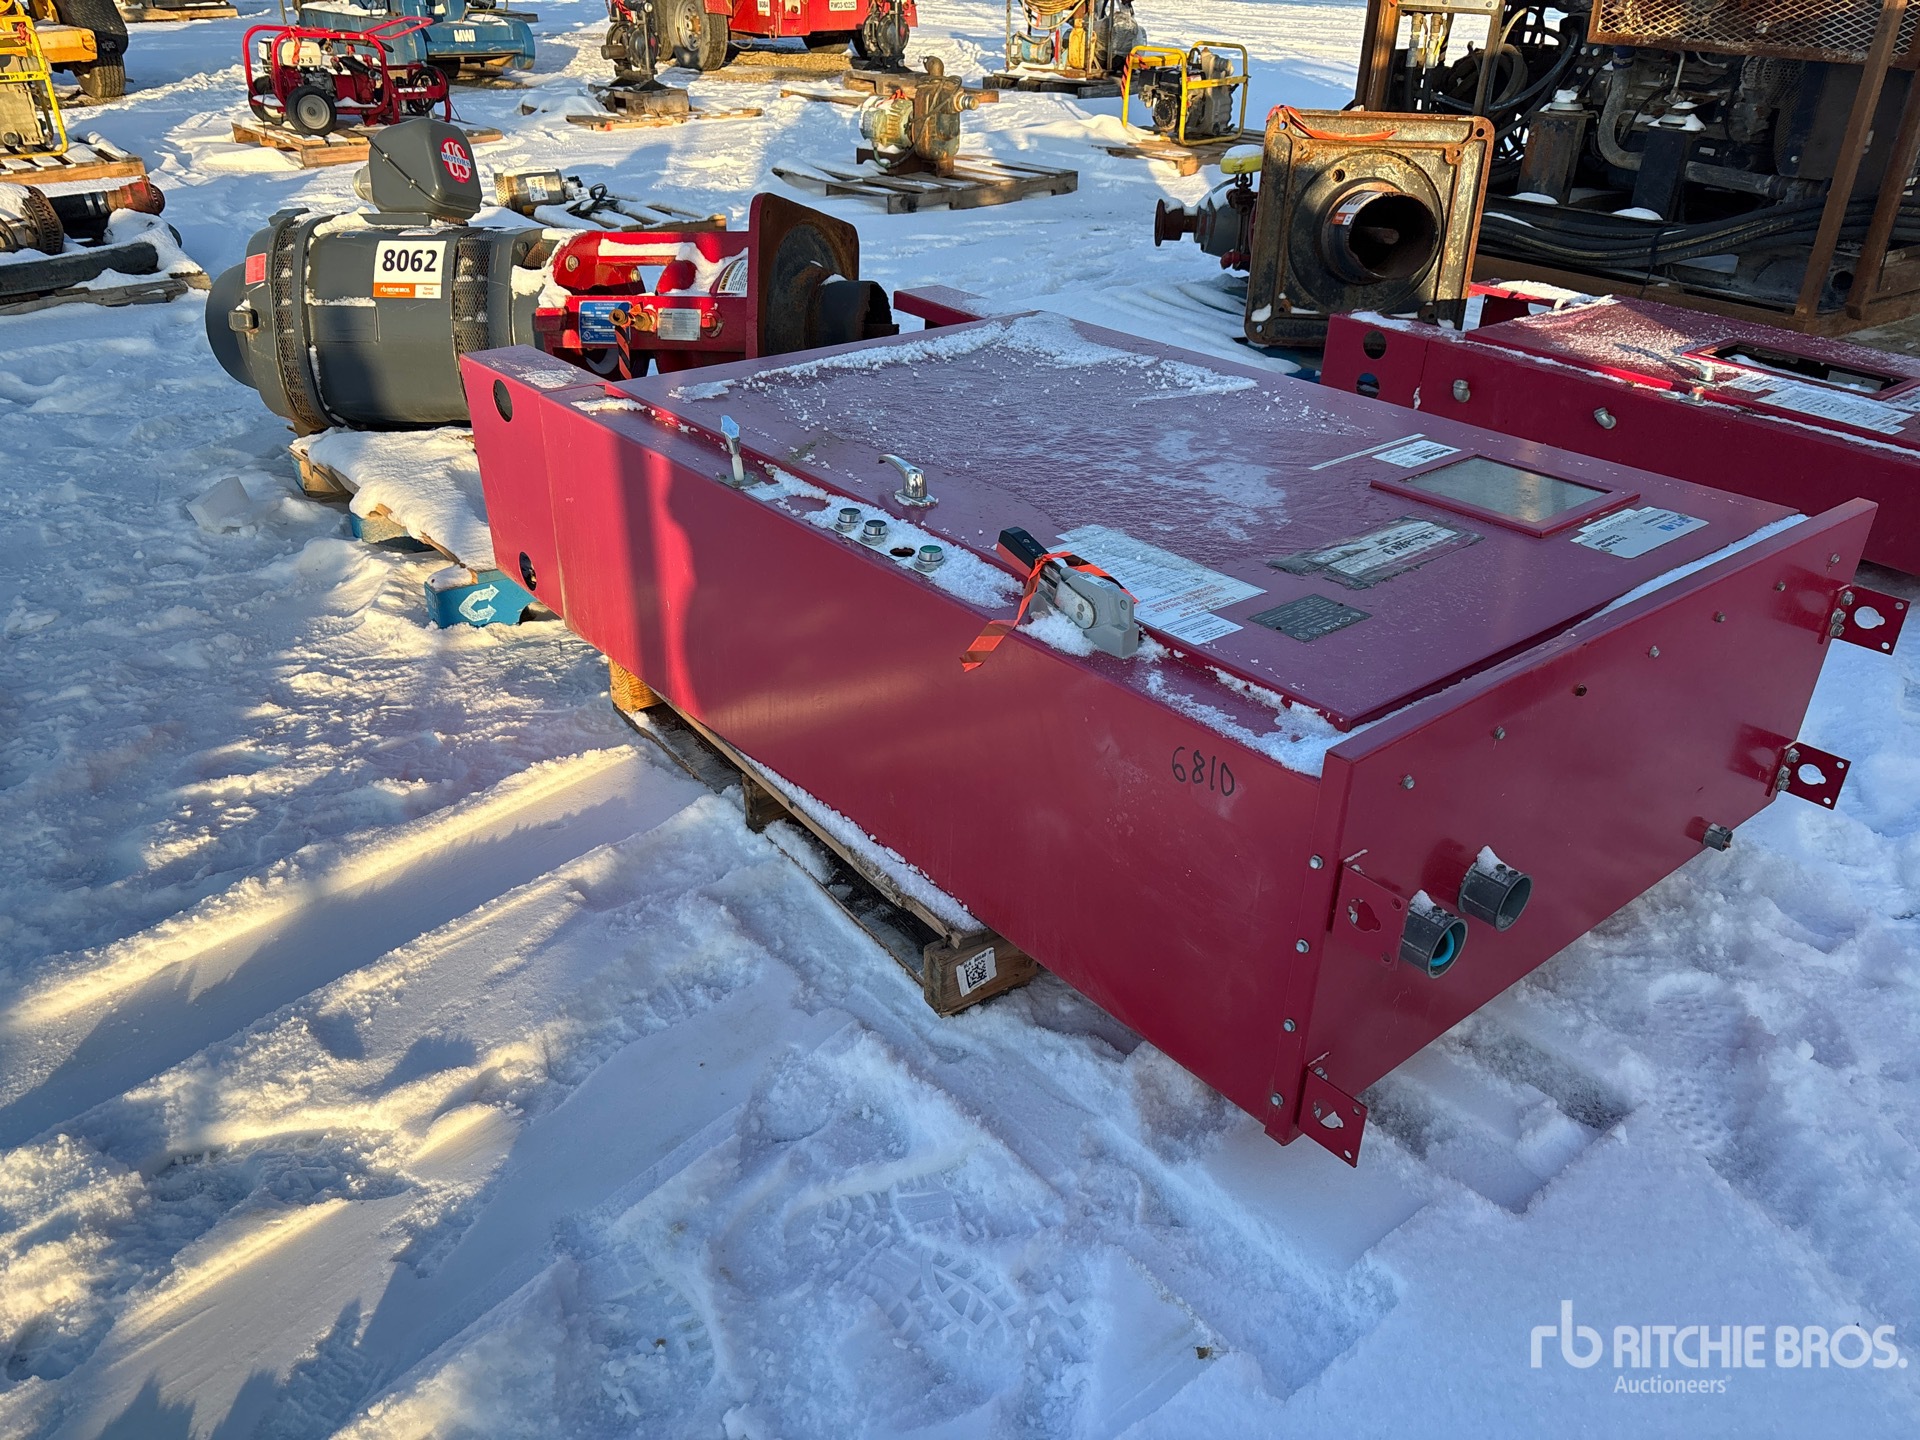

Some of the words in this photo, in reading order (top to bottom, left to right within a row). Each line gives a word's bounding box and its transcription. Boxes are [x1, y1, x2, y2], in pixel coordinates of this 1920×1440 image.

[453, 29, 476, 42] MWI
[442, 153, 471, 167] MOTORS
[382, 249, 438, 272] 8062
[1172, 746, 1235, 796] 6810
